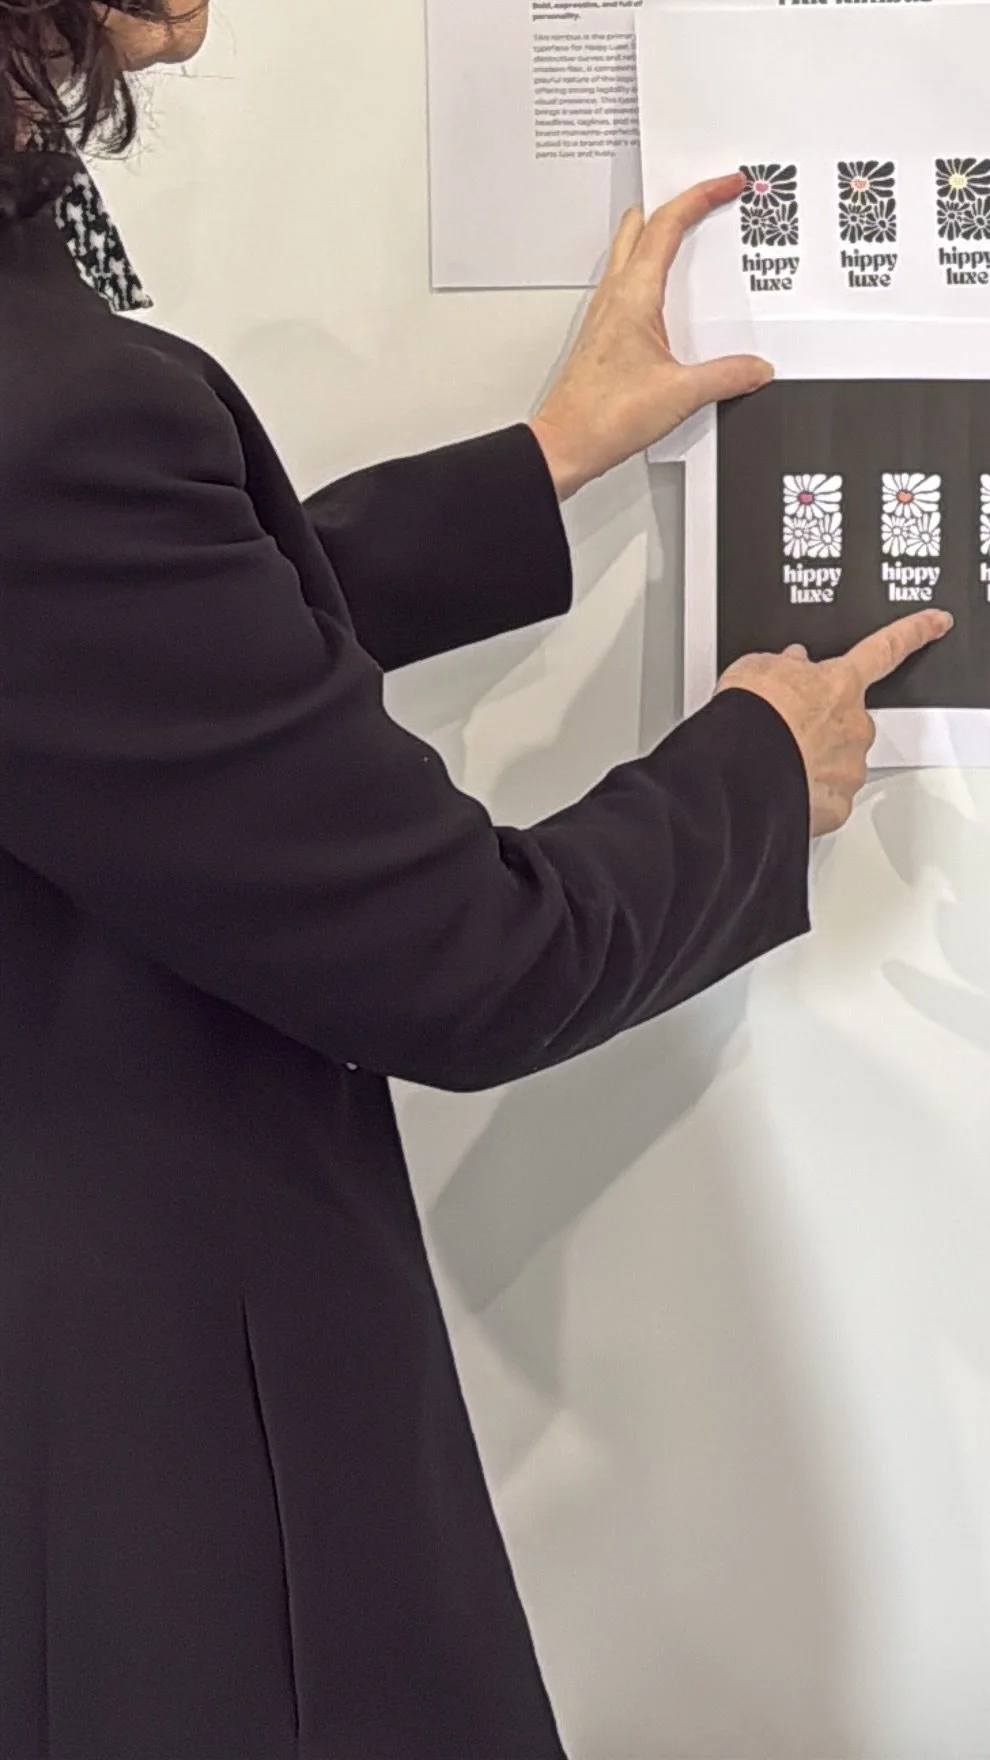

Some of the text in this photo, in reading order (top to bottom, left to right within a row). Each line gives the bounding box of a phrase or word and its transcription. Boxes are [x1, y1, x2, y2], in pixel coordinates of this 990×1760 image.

[618, 0, 632, 7] full
[742, 254, 799, 276] hippy
[841, 250, 897, 272] hippy
[750, 275, 792, 291] luxe
[849, 271, 891, 287] luxe
[946, 268, 988, 284] luxe
[784, 565, 841, 586] hippy
[883, 562, 940, 583] hippy
[791, 586, 833, 603] luxe
[889, 583, 932, 601] luxe
